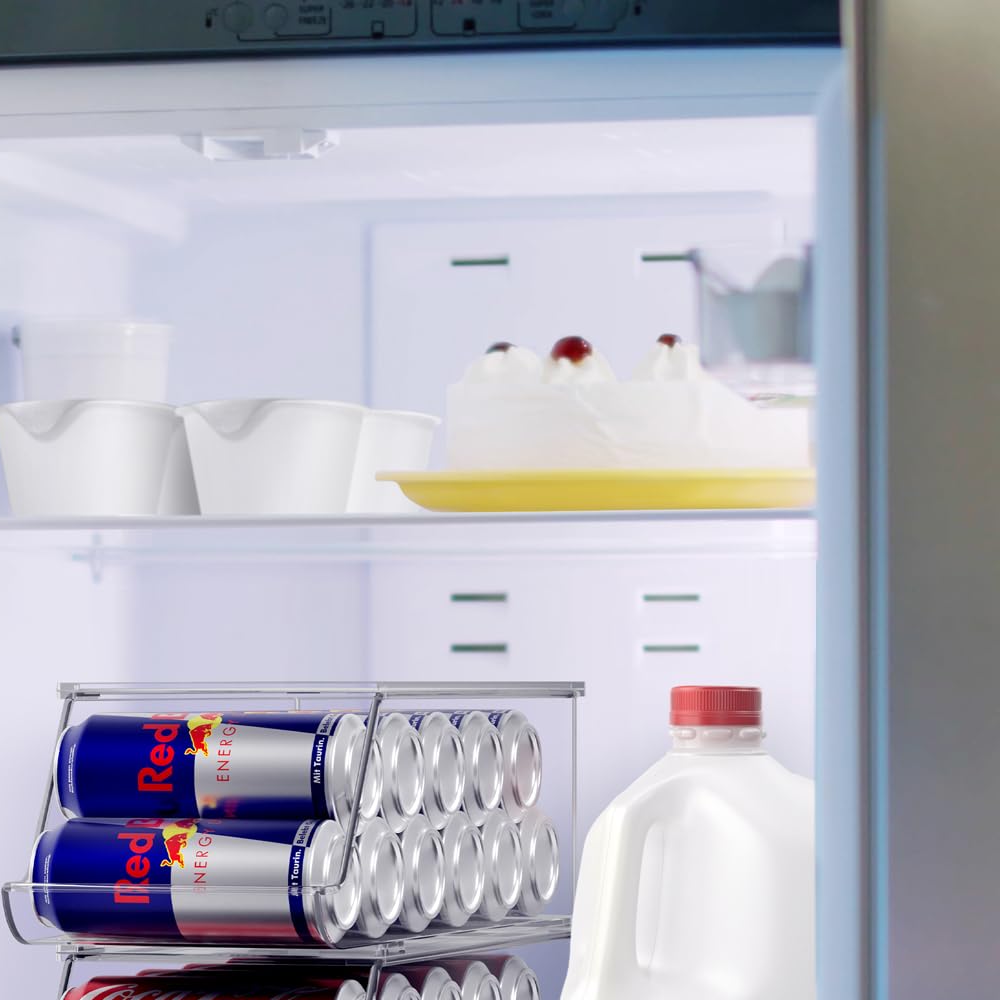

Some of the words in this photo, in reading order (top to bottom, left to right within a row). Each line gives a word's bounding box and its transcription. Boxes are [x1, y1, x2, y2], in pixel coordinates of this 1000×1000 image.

[137, 723, 181, 791] Red
[313, 736, 326, 767] Taurin.
[313, 769, 321, 784] Mit
[114, 832, 157, 903] Red
[290, 849, 302, 880] Taurin.
